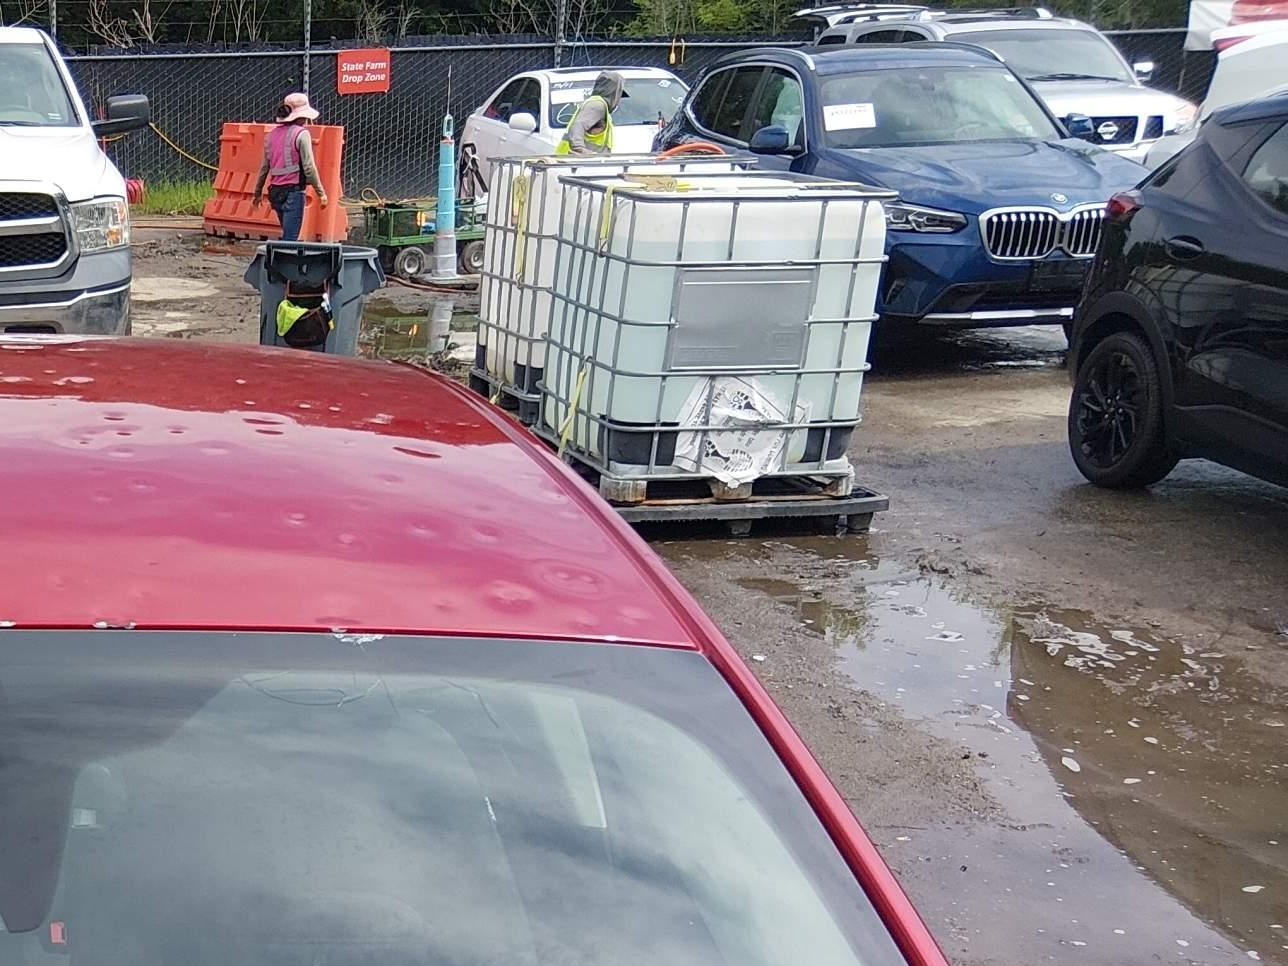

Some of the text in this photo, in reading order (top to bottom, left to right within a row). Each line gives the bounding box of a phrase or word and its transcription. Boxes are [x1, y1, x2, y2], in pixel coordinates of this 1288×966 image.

[341, 62, 387, 71] State Farm
[342, 72, 386, 84] Drop Zone
